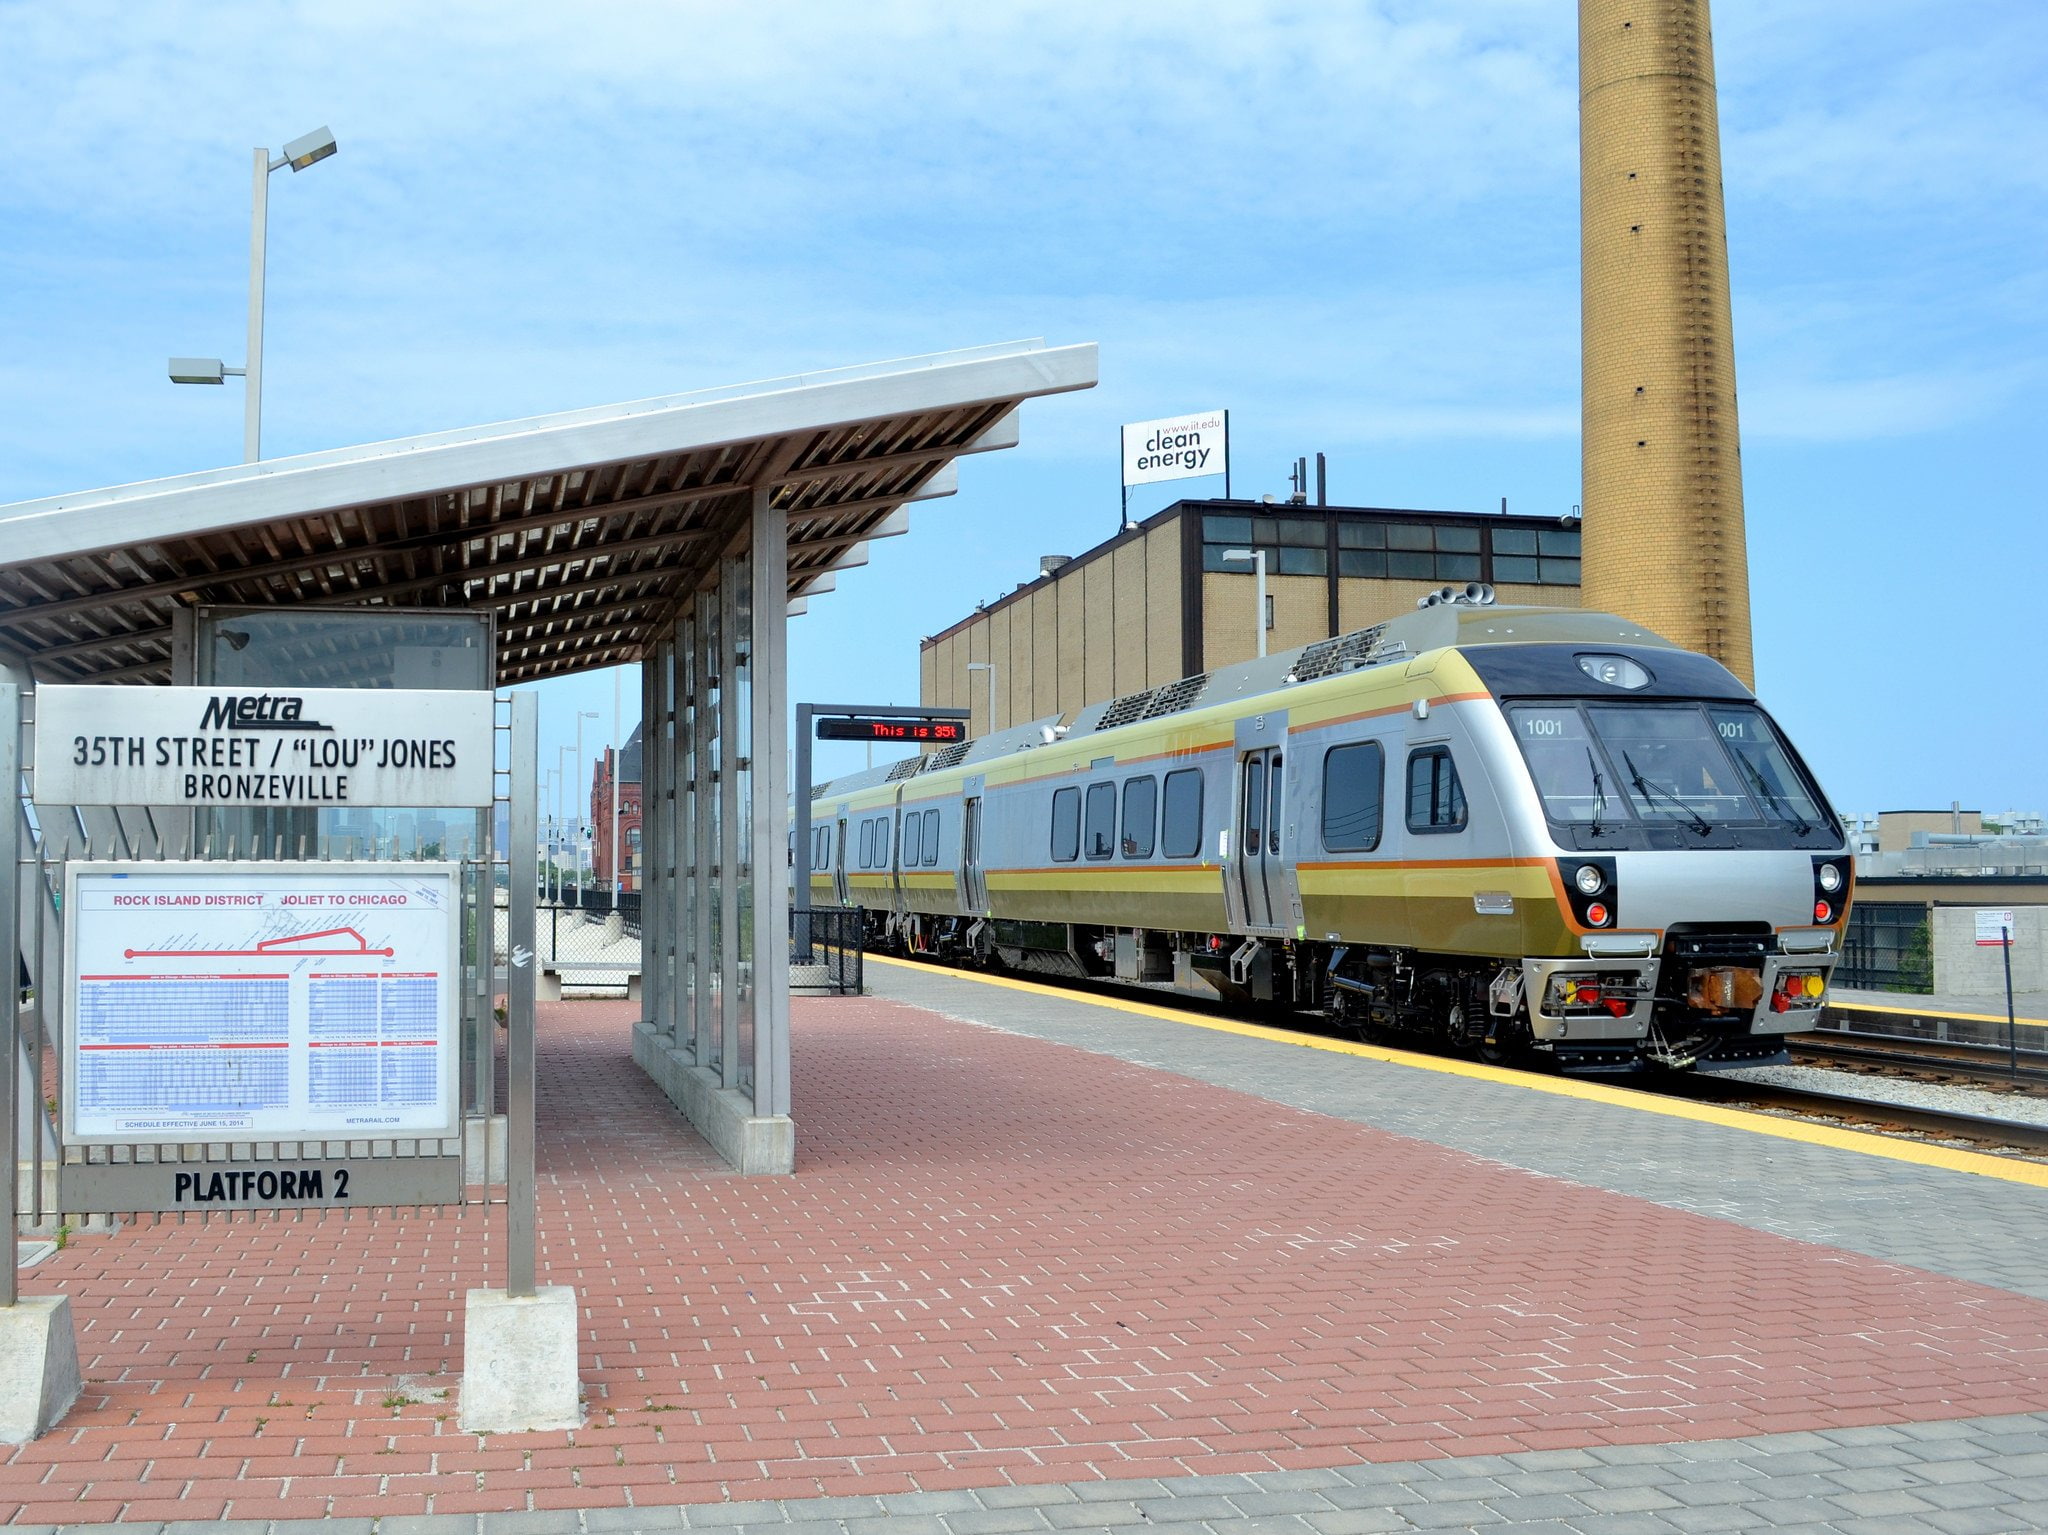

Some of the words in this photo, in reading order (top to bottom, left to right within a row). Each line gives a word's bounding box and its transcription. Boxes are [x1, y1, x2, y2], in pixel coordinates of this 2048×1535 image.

[1162, 416, 1221, 435] www.iit.edu
[1146, 429, 1201, 452] clean
[1137, 447, 1211, 470] energy
[199, 693, 304, 730] Metra
[872, 723, 904, 737] This
[913, 725, 928, 737] is
[934, 725, 957, 738] 35t
[1526, 719, 1563, 736] 1001
[1717, 722, 1743, 738] 001
[73, 736, 145, 767] 35TH
[155, 737, 260, 768] STREET
[269, 738, 284, 769] /
[377, 739, 457, 769] JONES
[184, 774, 348, 800] BRONZEVILLE
[113, 895, 151, 906] ROCK
[154, 895, 201, 906] ISLAND
[204, 895, 264, 906] DISTRICT
[281, 895, 325, 906] JOLIET
[328, 895, 345, 906] TO
[348, 895, 407, 906] CHICAGO
[175, 1170, 324, 1202] PLATFORM
[333, 1169, 350, 1199] 2
